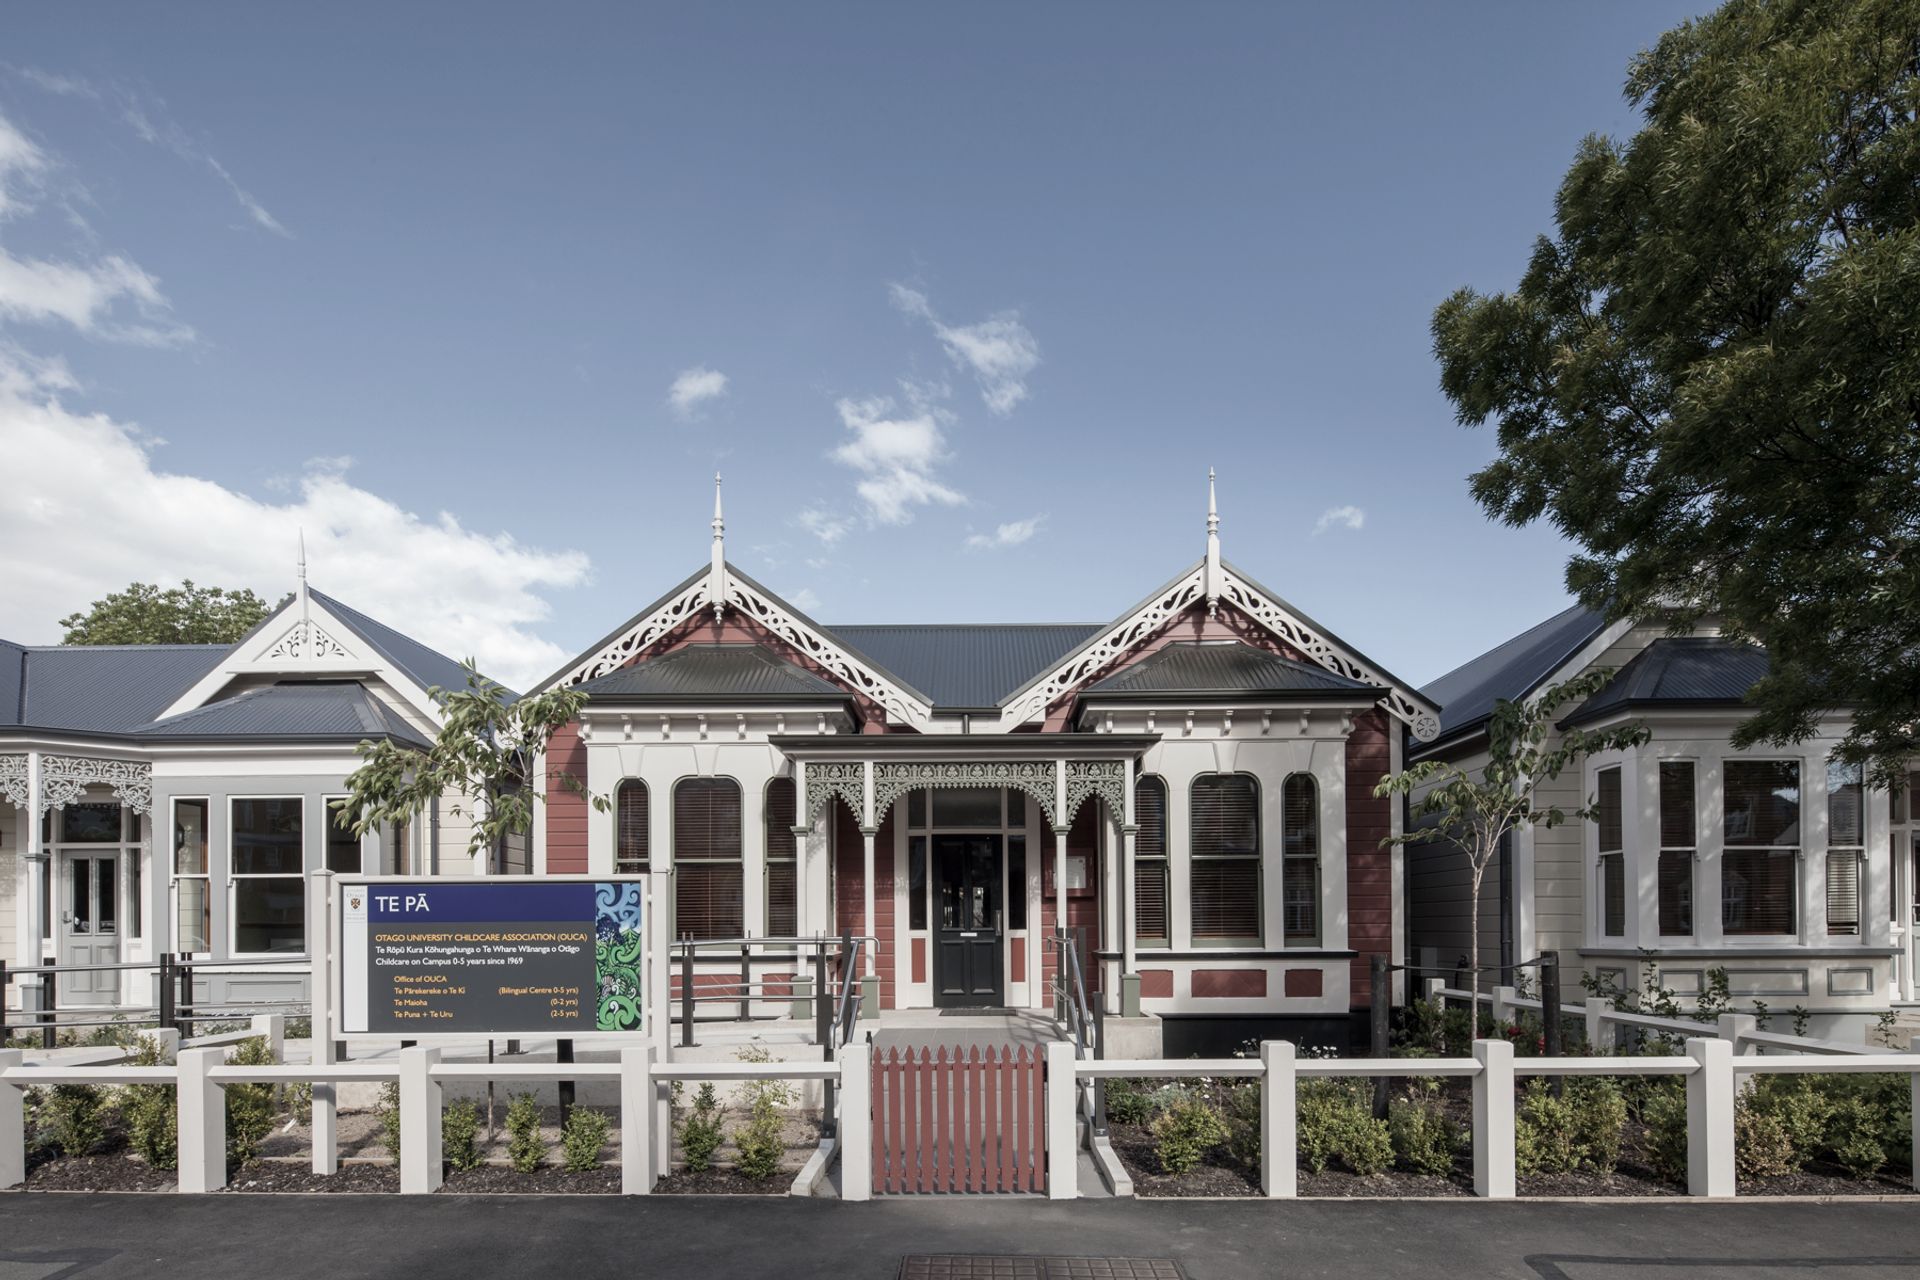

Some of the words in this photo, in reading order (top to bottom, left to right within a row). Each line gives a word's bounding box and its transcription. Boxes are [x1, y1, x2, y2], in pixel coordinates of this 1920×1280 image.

[375, 896, 399, 912] TE
[406, 893, 429, 912] PĀ
[376, 934, 405, 942] OTAGO
[407, 934, 453, 942] UNIVERSITY
[455, 934, 500, 942] CHILDCARE
[502, 933, 556, 941] ASSOCIATION
[557, 933, 587, 943] (OUCA)
[376, 946, 385, 954] Te
[407, 946, 423, 954] Kura
[482, 945, 491, 953] Te
[493, 945, 517, 953] Whare
[376, 957, 410, 966] Childcare
[422, 957, 451, 967] Campus
[453, 957, 465, 965] 0-5
[466, 959, 485, 967] years
[487, 957, 505, 965] since
[508, 957, 523, 966] 1969
[394, 975, 414, 983] Office
[415, 975, 423, 983] of
[424, 975, 447, 983] OUCA
[394, 987, 403, 995] Te
[449, 987, 457, 995] Te
[498, 987, 528, 996] (Bilingual
[566, 987, 578, 996] yrs)
[551, 998, 564, 1007] (0-2
[565, 998, 578, 1007] yrs)
[394, 1010, 403, 1018] Te
[404, 1010, 421, 1018] Puna
[429, 1010, 438, 1018] Te
[440, 1010, 453, 1018] Uru
[551, 1010, 564, 1018] (2-5
[565, 1010, 578, 1019] yrs)
